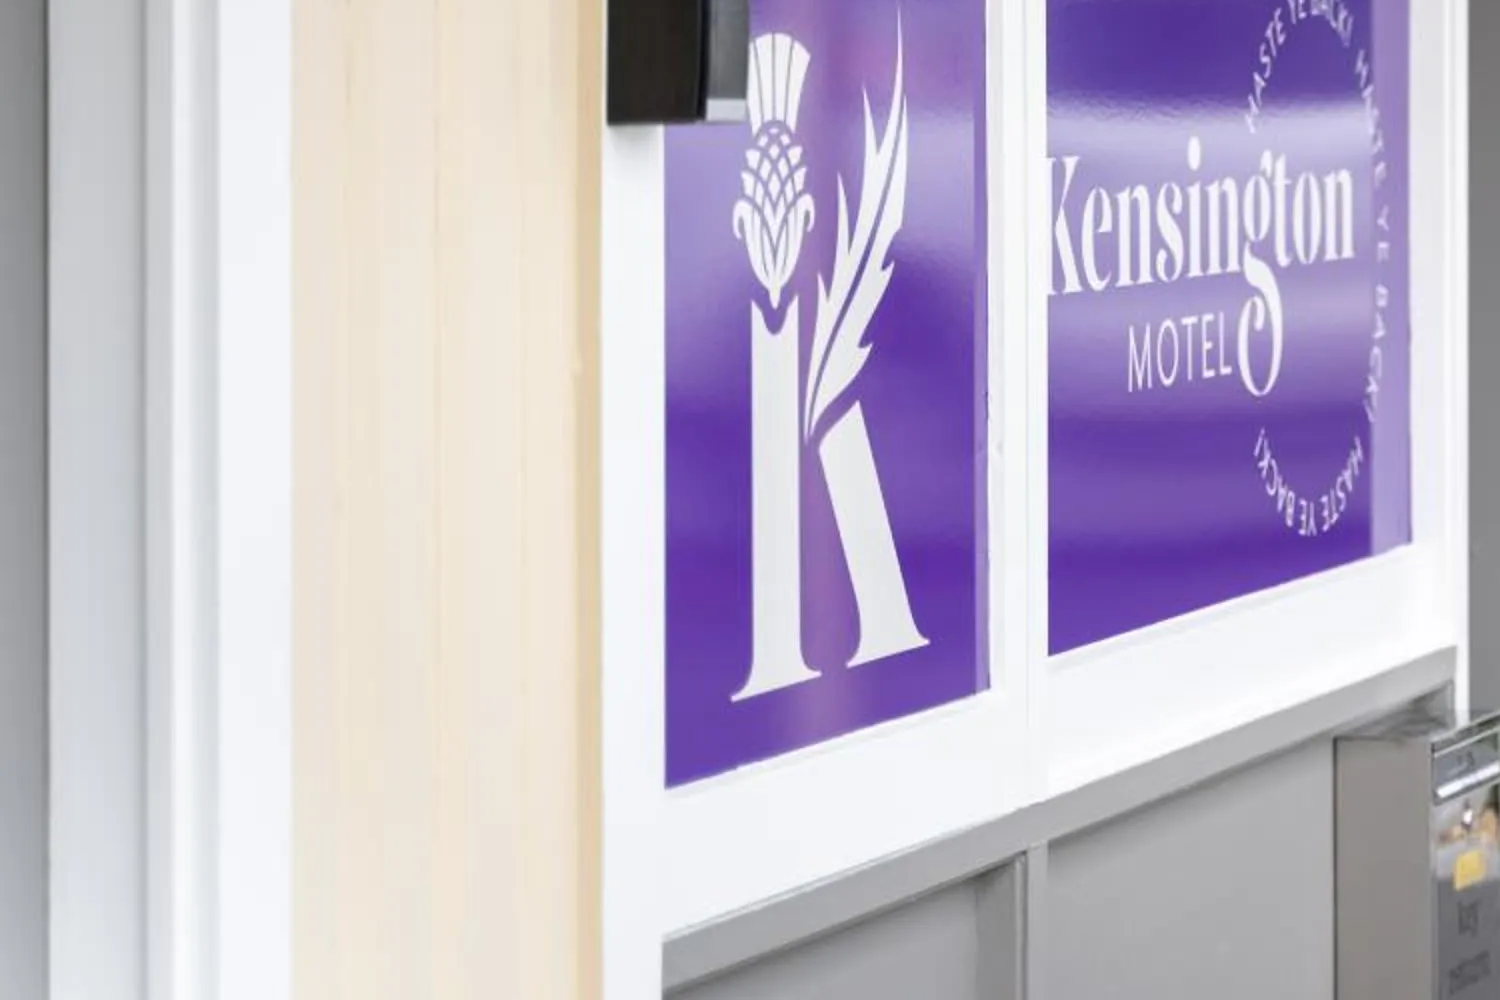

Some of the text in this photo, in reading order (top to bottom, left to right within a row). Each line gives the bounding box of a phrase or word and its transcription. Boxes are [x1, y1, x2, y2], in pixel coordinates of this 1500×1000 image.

[1245, 6, 1287, 135] HASTE
[1046, 135, 1355, 397] Kensington
[1127, 311, 1233, 393] MOTEL
[1298, 497, 1318, 538] YE
